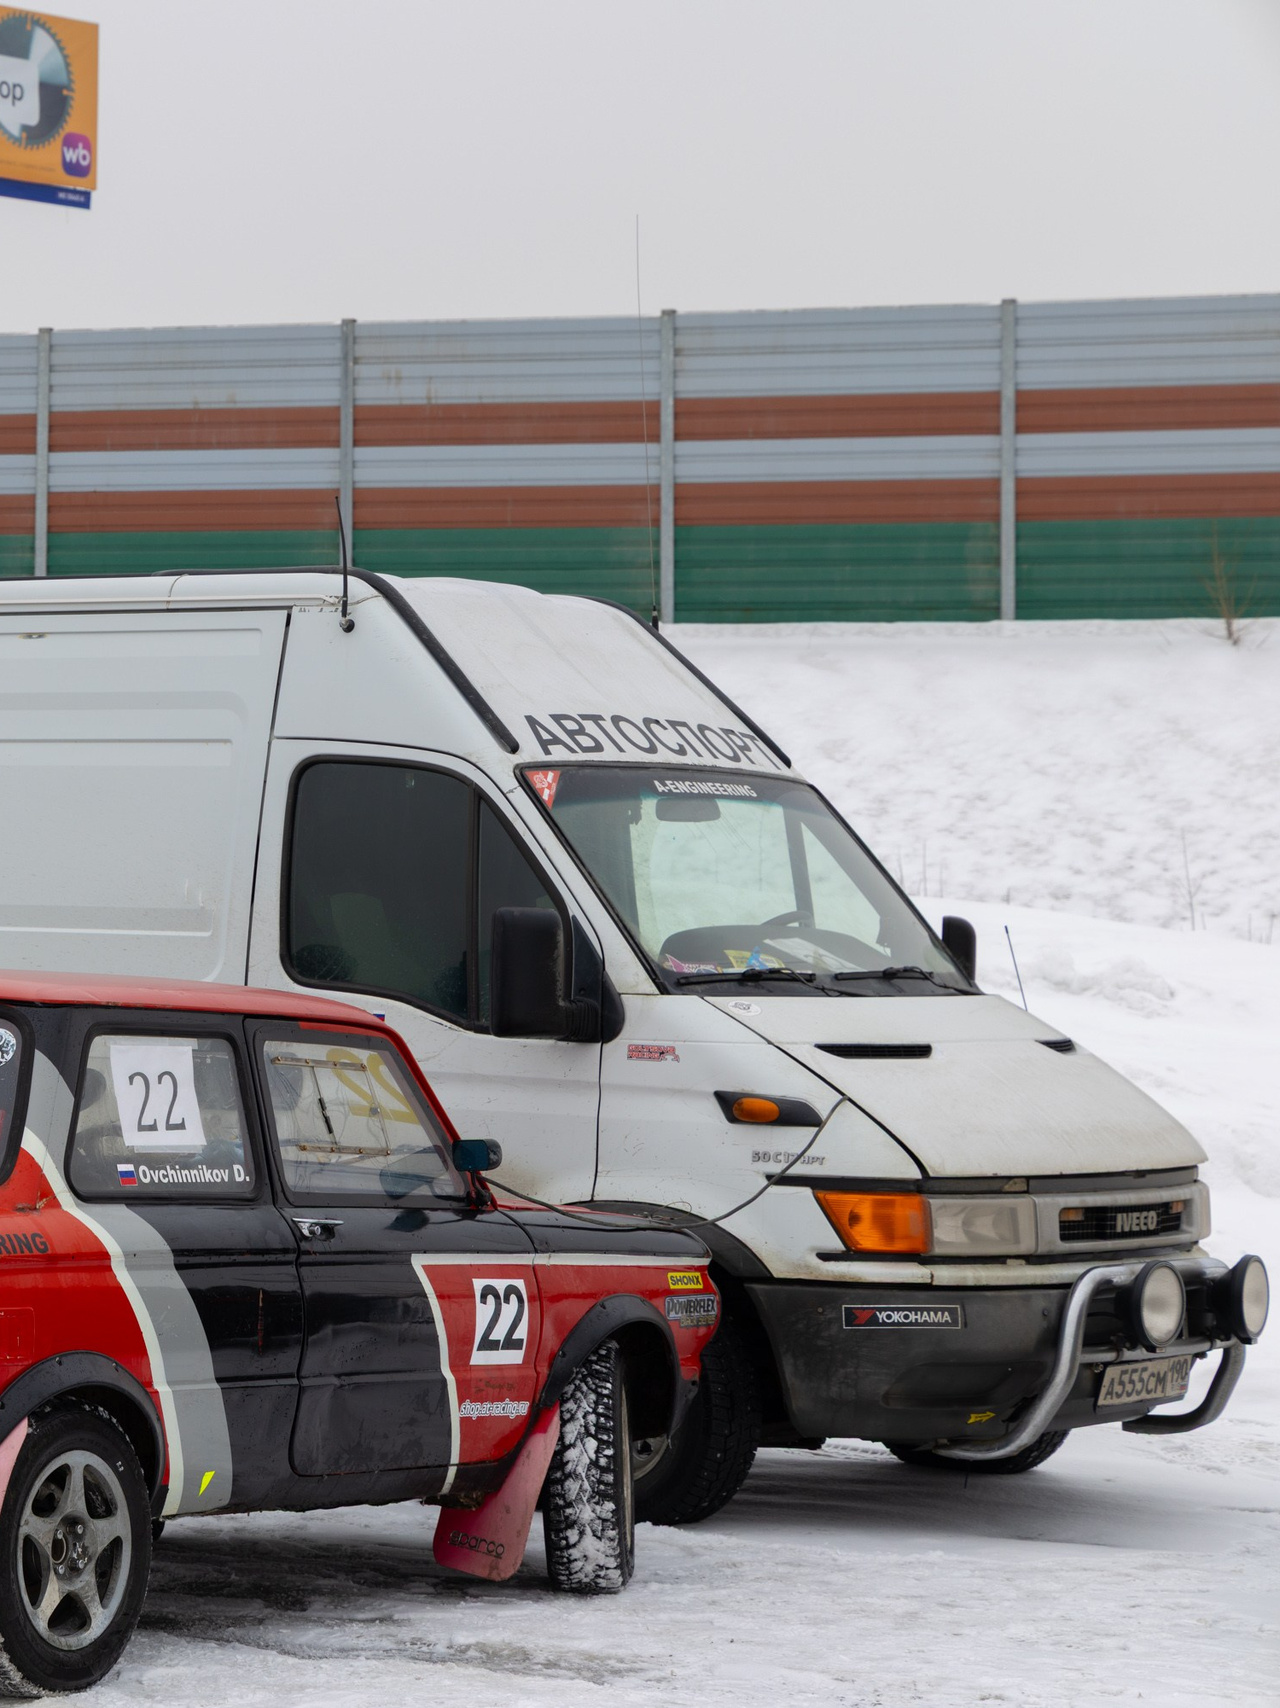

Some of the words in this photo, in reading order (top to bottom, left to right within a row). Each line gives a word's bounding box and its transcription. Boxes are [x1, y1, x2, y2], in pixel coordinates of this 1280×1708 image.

[63, 142, 91, 167] wb
[523, 713, 782, 770] АВТОСПОРТ
[653, 780, 758, 797] A-ENGINEERING
[128, 1070, 187, 1132] 22
[138, 1165, 228, 1183] Ovchinnikov
[233, 1164, 250, 1182] D.
[1116, 1209, 1158, 1233] IVECO
[670, 1275, 701, 1286] SHONX
[476, 1284, 525, 1351] 22
[667, 1298, 715, 1315] POWERFLEX
[876, 1310, 952, 1325] YOKOHAMA
[1170, 1358, 1189, 1383] 190
[460, 1398, 529, 1420] shop.at-racing.ru
